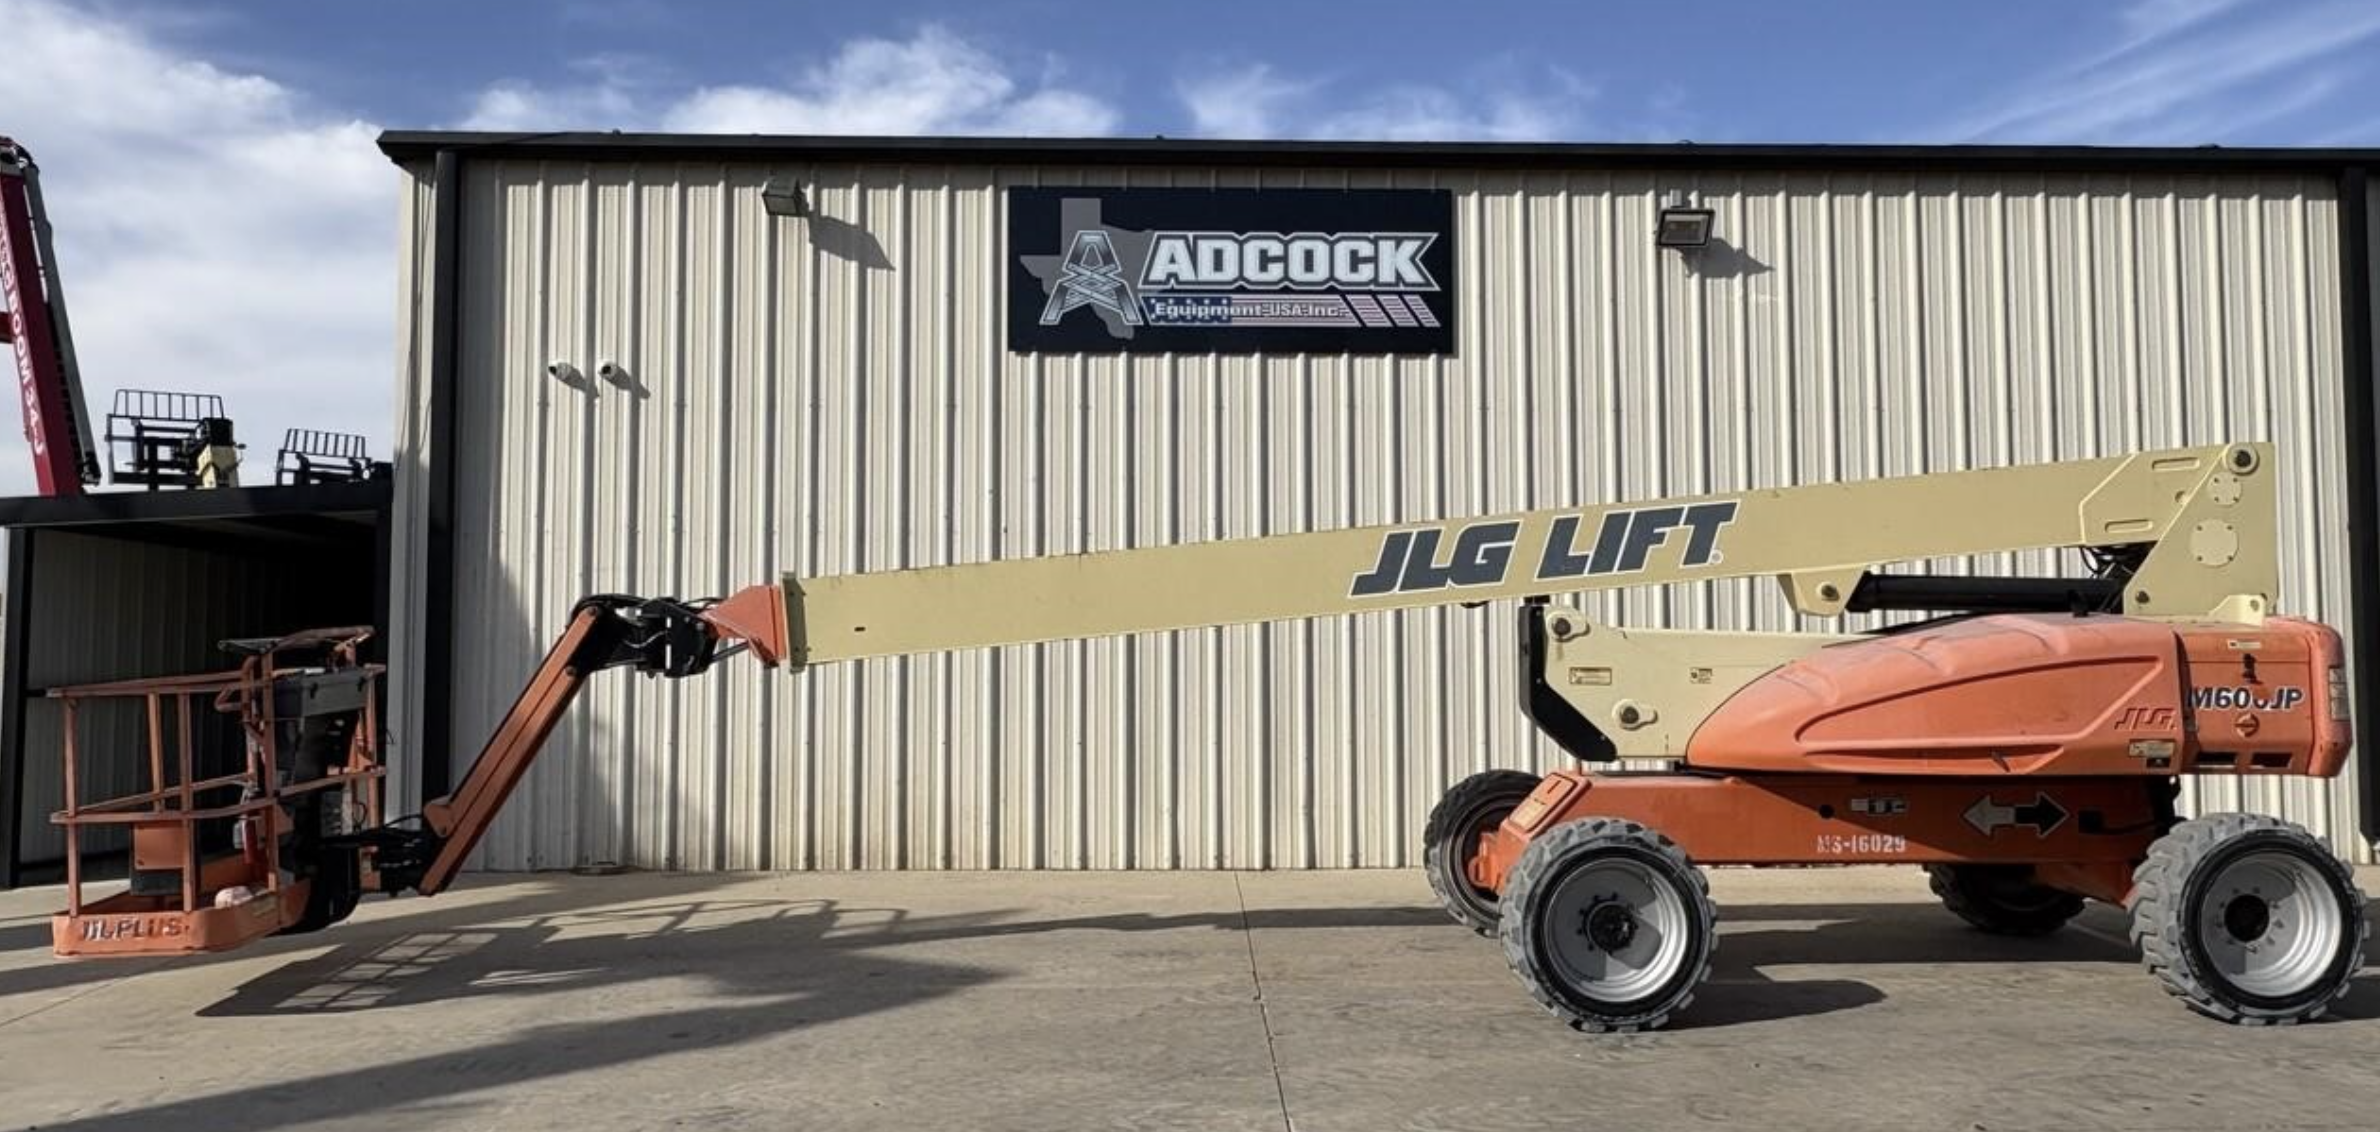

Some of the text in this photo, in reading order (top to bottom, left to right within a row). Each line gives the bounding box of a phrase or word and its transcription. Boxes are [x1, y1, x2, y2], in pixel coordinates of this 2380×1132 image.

[1142, 233, 1437, 289] ADCOCK
[1154, 302, 1262, 319] Equipment
[1269, 303, 1301, 317] USA
[1348, 501, 1740, 598] JLG LIFT
